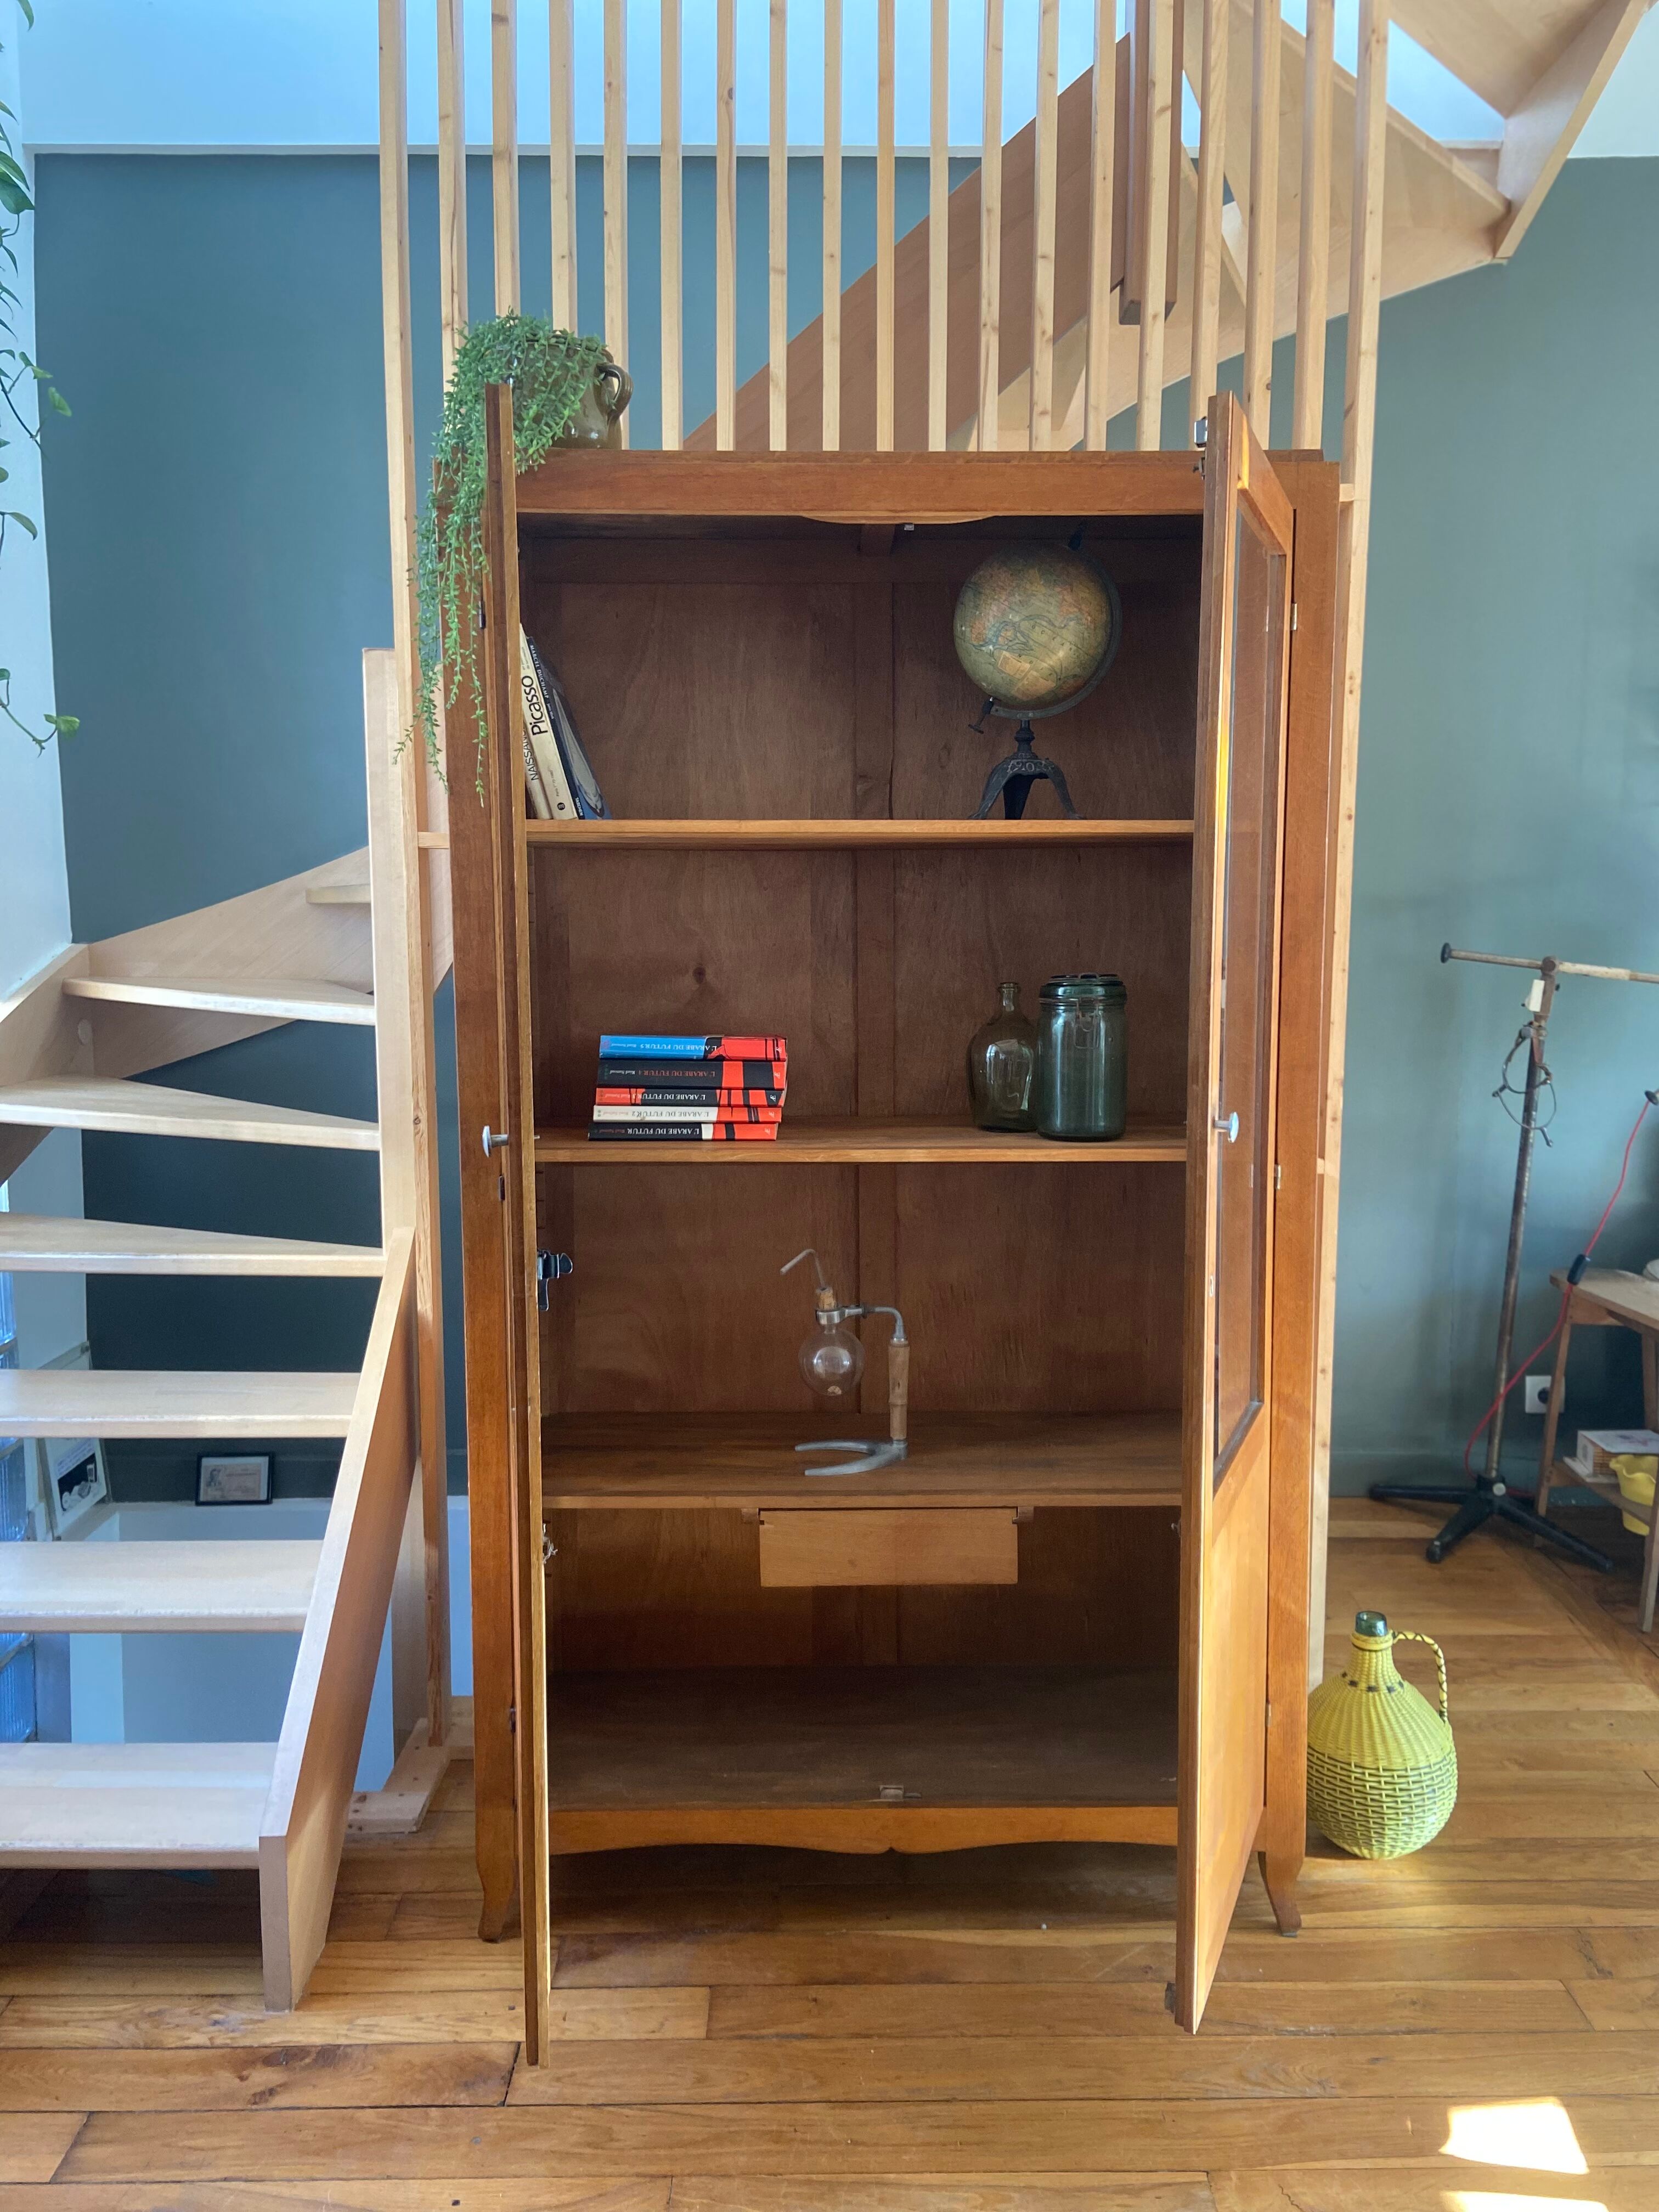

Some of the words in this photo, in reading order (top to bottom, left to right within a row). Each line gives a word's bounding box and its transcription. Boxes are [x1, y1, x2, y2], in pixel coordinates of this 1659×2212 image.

[529, 645, 540, 668] MARCEL
[537, 669, 549, 698] DUCHAMP
[521, 675, 548, 736] Picasso
[575, 797, 584, 816] TASCHEN
